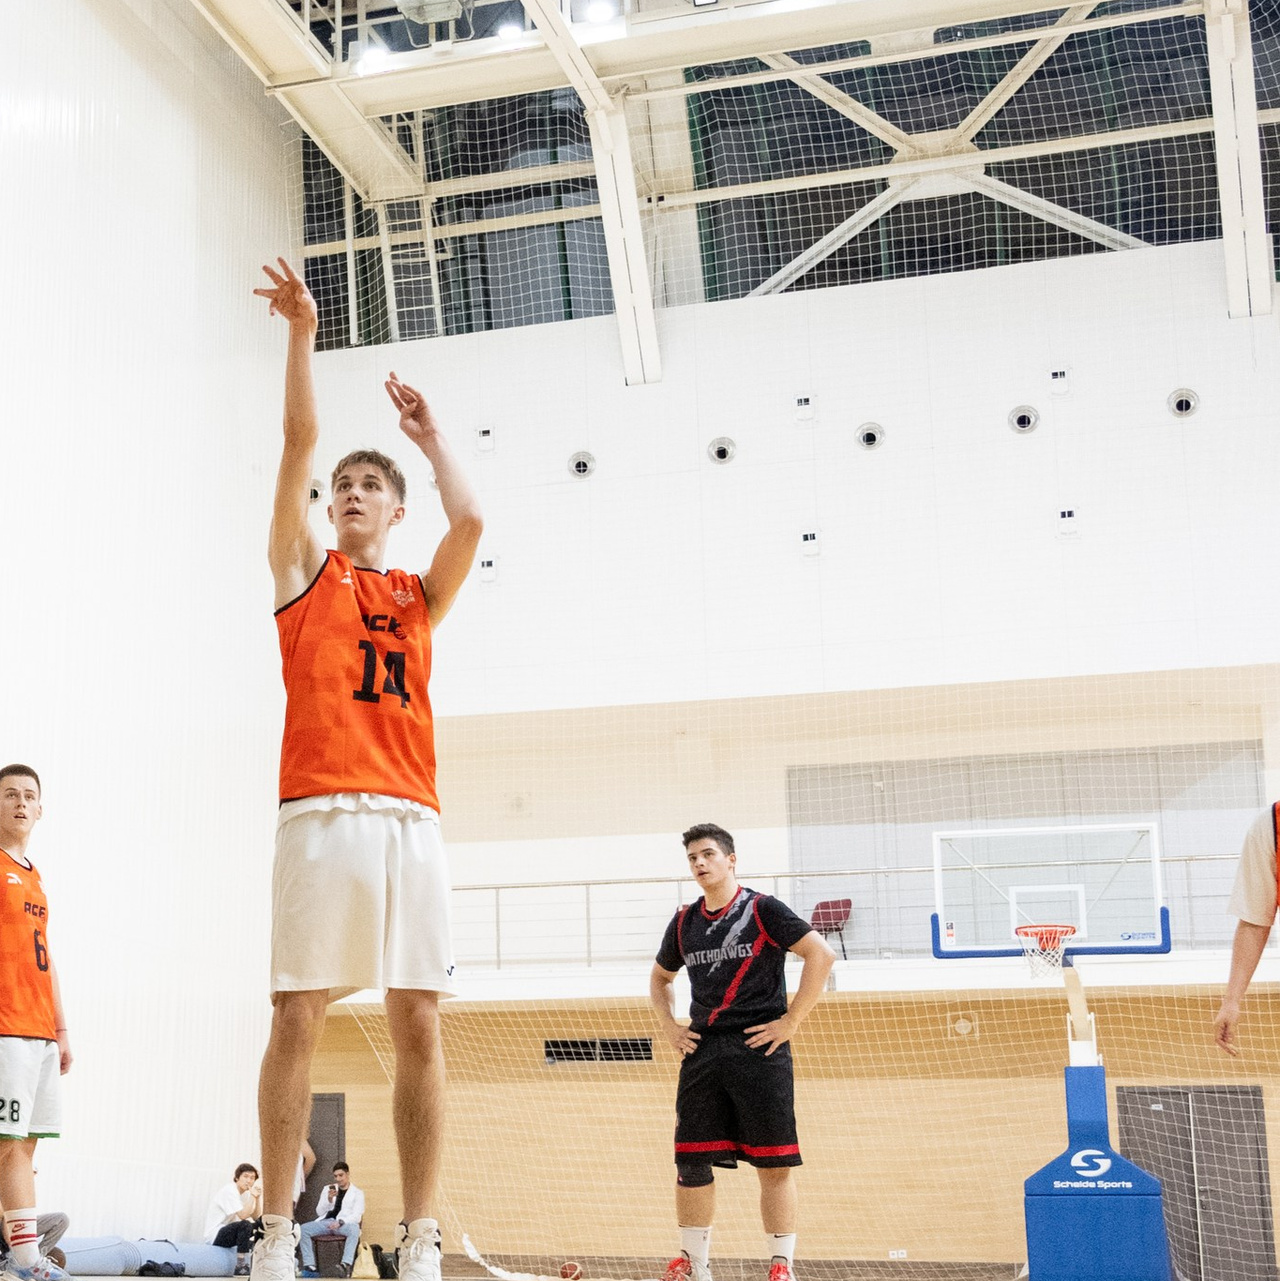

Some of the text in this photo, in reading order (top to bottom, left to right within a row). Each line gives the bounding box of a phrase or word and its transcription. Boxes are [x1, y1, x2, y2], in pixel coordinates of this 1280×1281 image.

[353, 640, 410, 709] 14
[33, 928, 49, 972] 6
[1097, 1180, 1133, 1189] Sports
